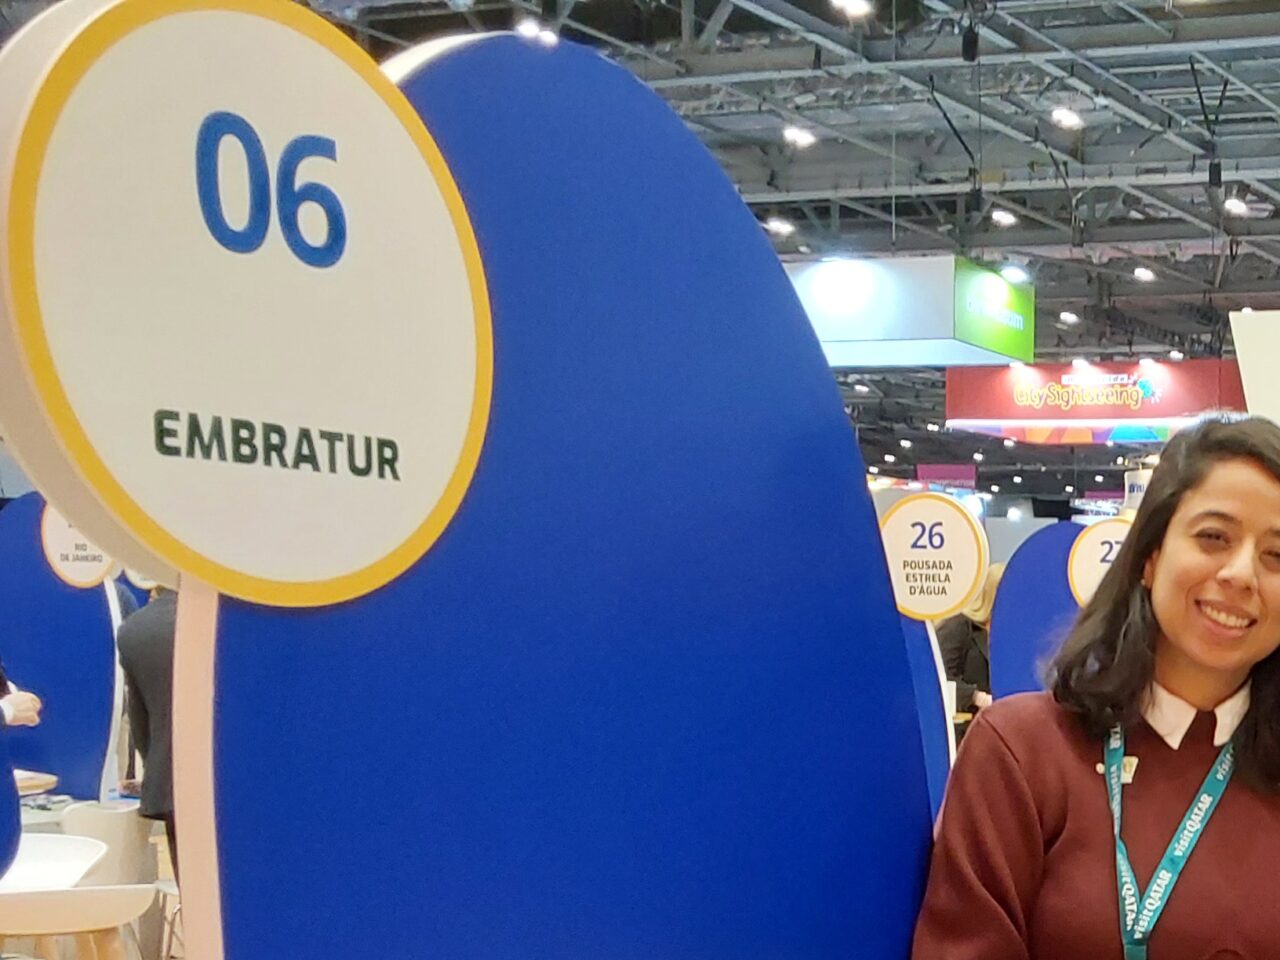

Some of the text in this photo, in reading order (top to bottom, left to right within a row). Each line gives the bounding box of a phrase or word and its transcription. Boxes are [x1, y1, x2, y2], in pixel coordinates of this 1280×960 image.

[195, 111, 347, 268] 06
[153, 409, 400, 481] EMBRATUR
[910, 522, 944, 549] 26
[903, 560, 953, 571] POUSADA
[905, 573, 951, 583] ESTRELA
